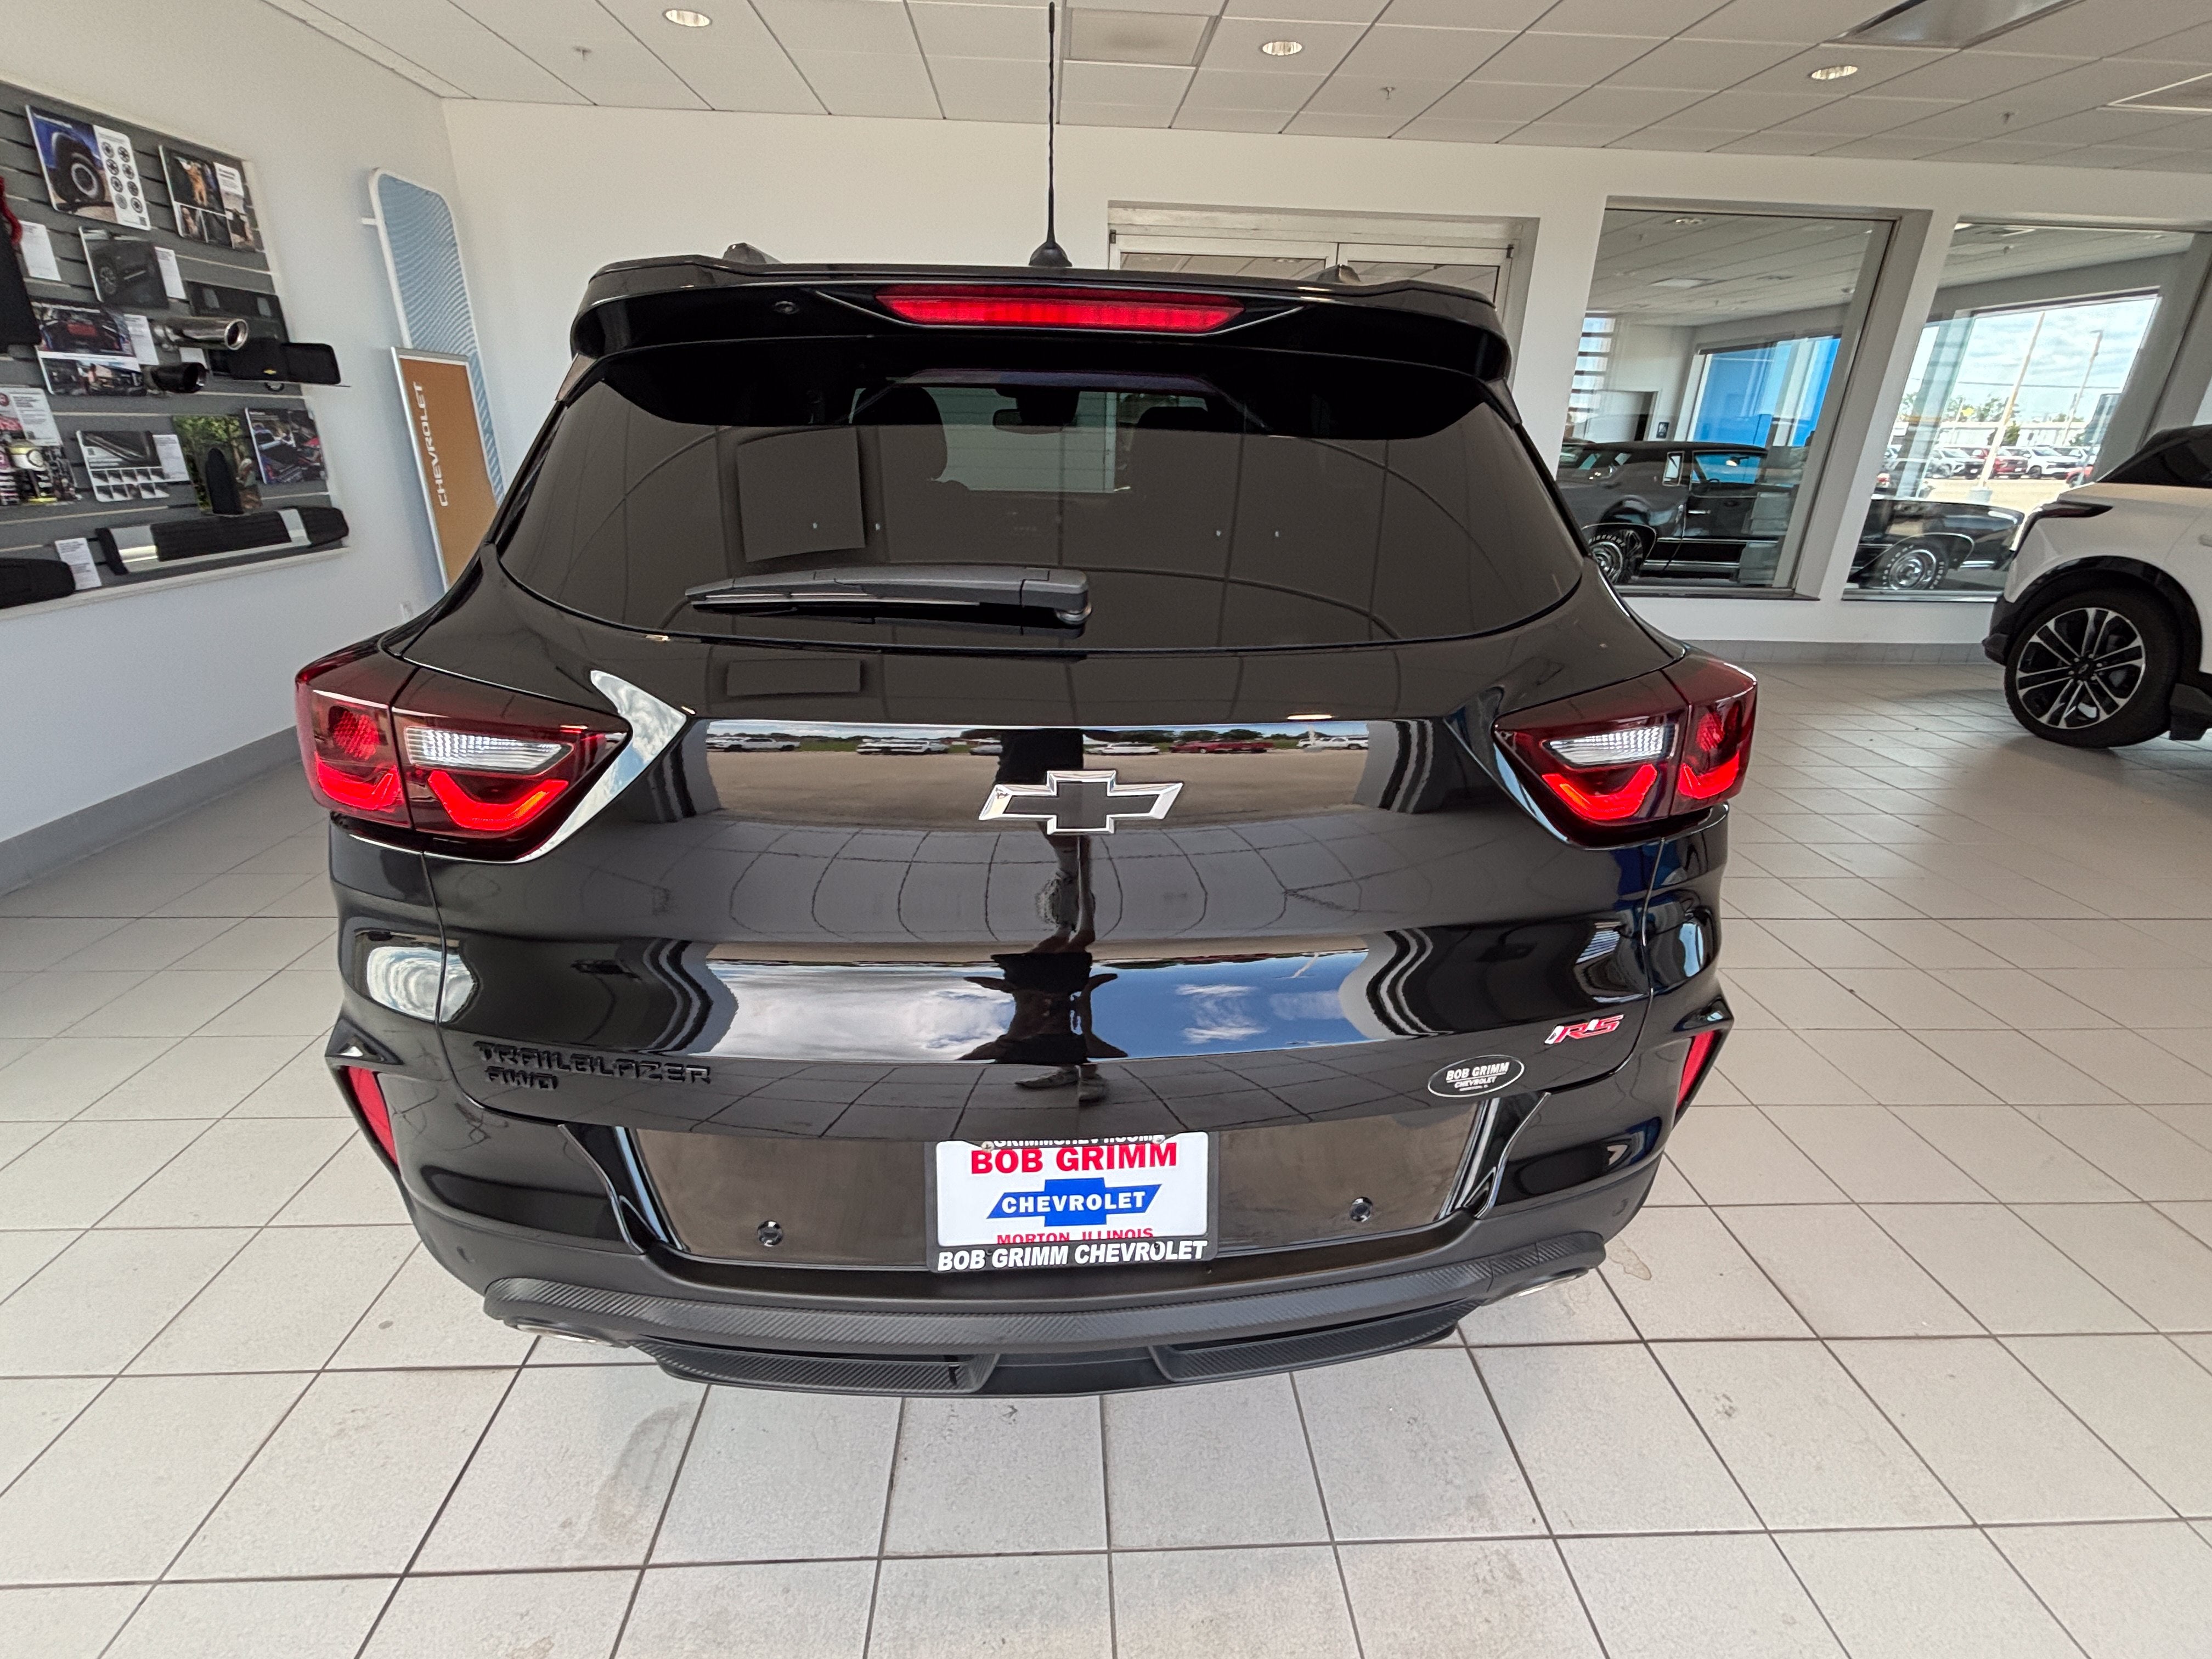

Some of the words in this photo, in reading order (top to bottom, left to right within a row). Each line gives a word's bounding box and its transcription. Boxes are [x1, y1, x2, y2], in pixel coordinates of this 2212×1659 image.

[413, 381, 448, 506] CHEVROLET
[1544, 1013, 1625, 1045] RS
[473, 1040, 711, 1084] TRAILBLAZER
[1446, 1068, 1470, 1081] BOB
[1472, 1062, 1510, 1076] GRIMM
[1454, 1076, 1497, 1088] CHEVROLET
[971, 1149, 1043, 1174] BOB
[1056, 1143, 1177, 1171] GRIMM
[1001, 1192, 1146, 1214] CHEVROLET
[996, 1232, 1070, 1244] MORTON
[937, 1250, 986, 1271] BOB
[992, 1245, 1068, 1267] GRIMM
[1074, 1241, 1208, 1263] CHEVROLET
